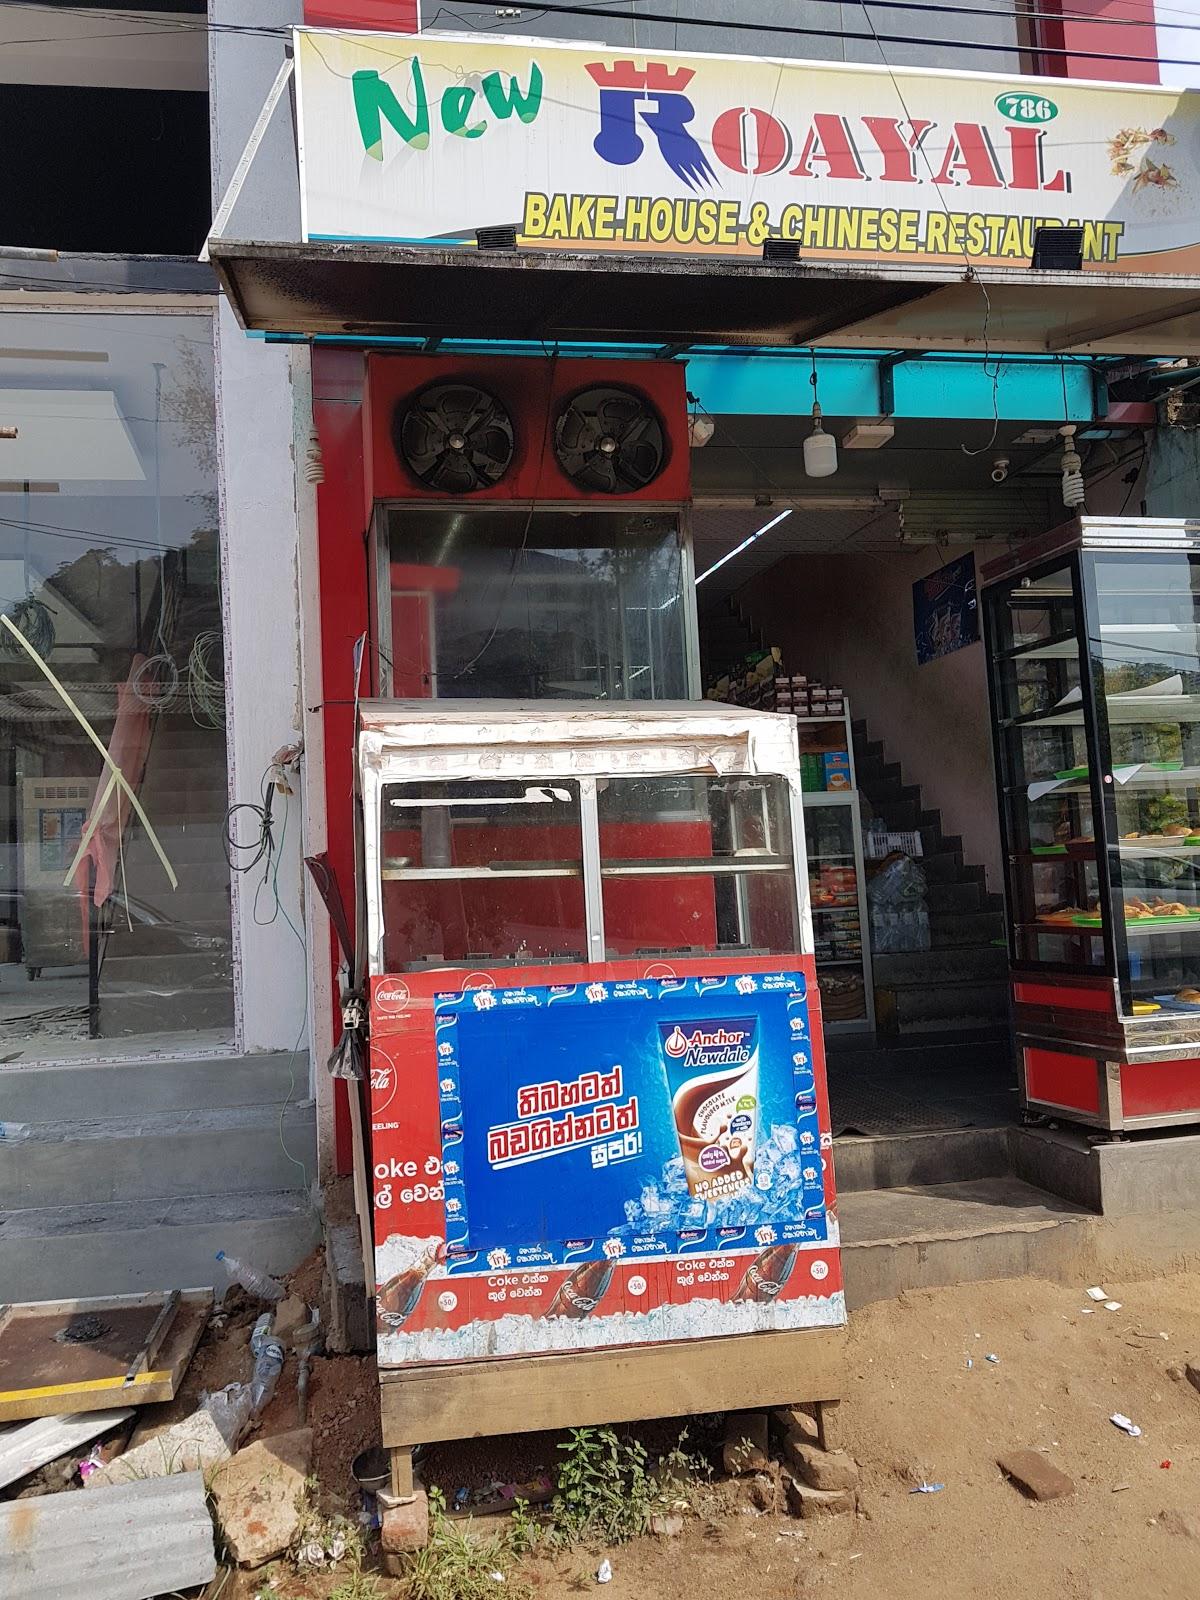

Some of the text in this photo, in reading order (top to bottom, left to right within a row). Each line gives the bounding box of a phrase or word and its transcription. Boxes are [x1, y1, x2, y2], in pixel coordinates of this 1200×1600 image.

[352, 56, 543, 162] New
[1005, 97, 1052, 119] 786
[588, 64, 1072, 193] ROAYAL
[523, 192, 1125, 263] BAKE HOUSE & CHINESE RESTAUNT
[689, 1029, 744, 1047] Anchor
[684, 1046, 750, 1067] Newdale
[698, 1092, 725, 1117] CHOCOLATE
[694, 1180, 709, 1193] NO
[711, 1170, 743, 1188] ADDED
[676, 1260, 705, 1271] Coke
[488, 1275, 518, 1287] Coke
